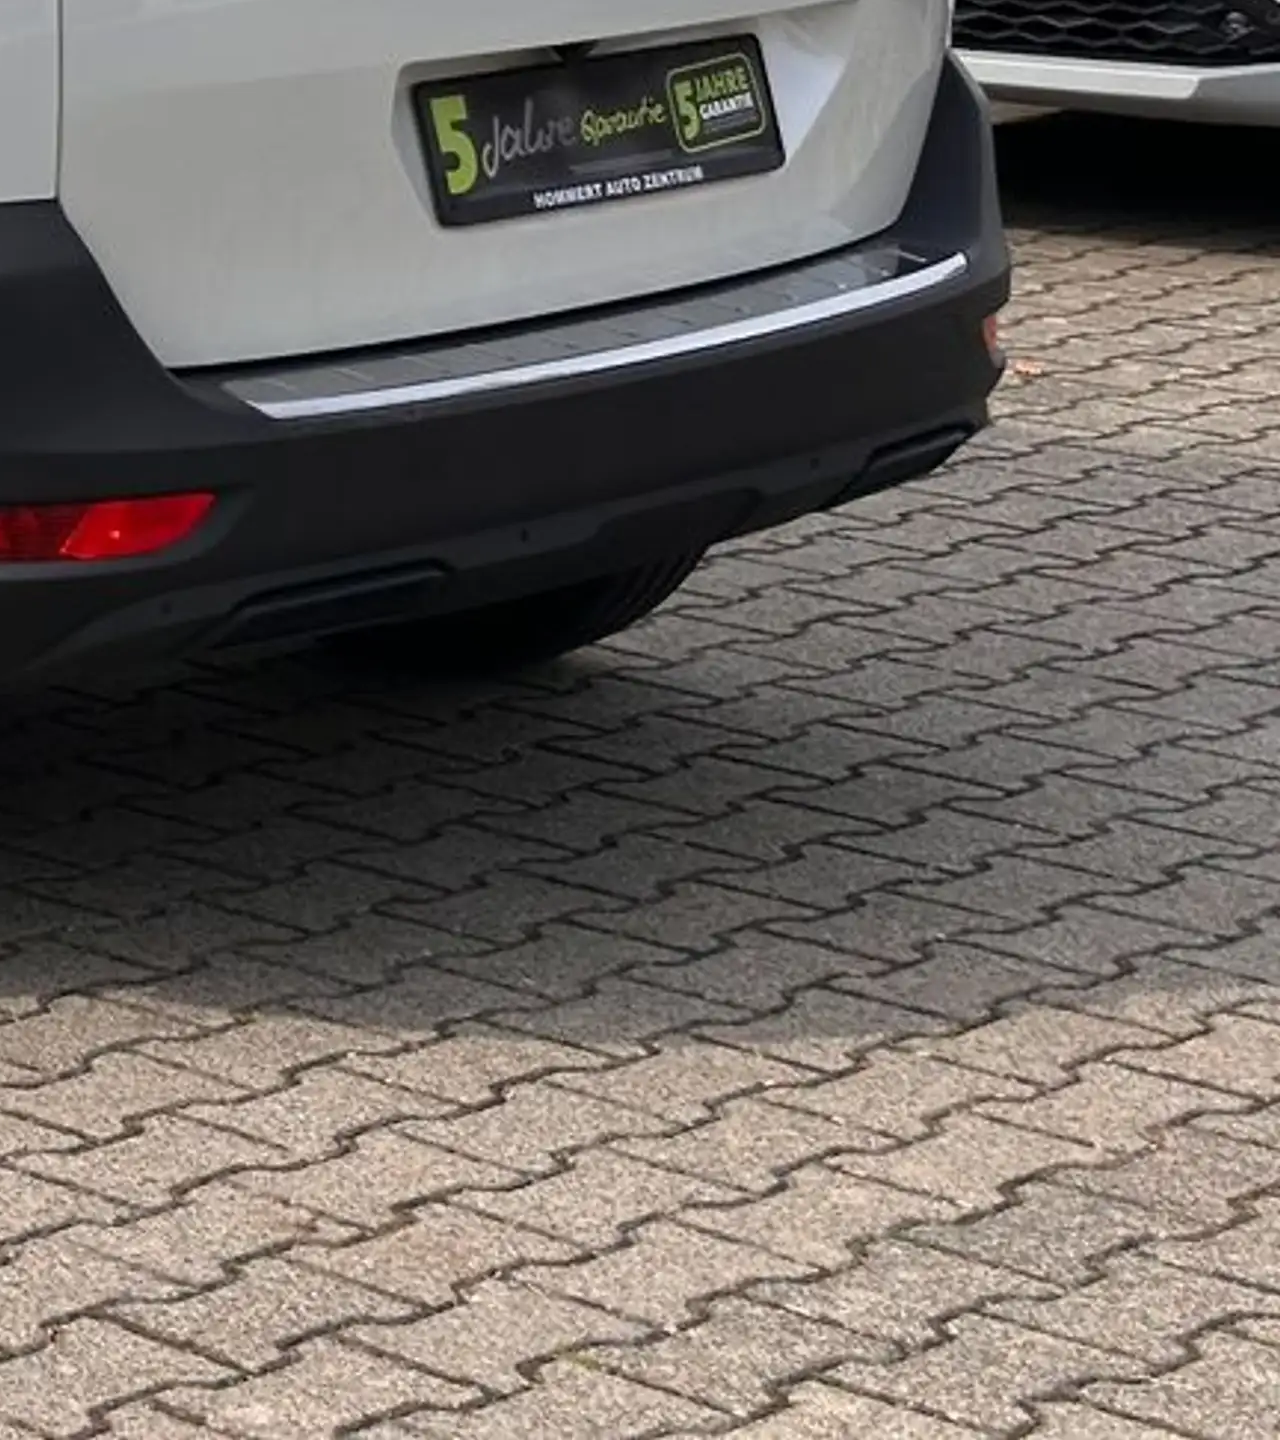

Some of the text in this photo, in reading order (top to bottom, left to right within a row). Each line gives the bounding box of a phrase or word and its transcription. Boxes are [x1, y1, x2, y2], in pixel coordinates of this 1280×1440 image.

[673, 79, 700, 140] 5
[694, 66, 750, 102] JAHRE
[429, 95, 479, 196] 5
[604, 176, 642, 197] AUTO
